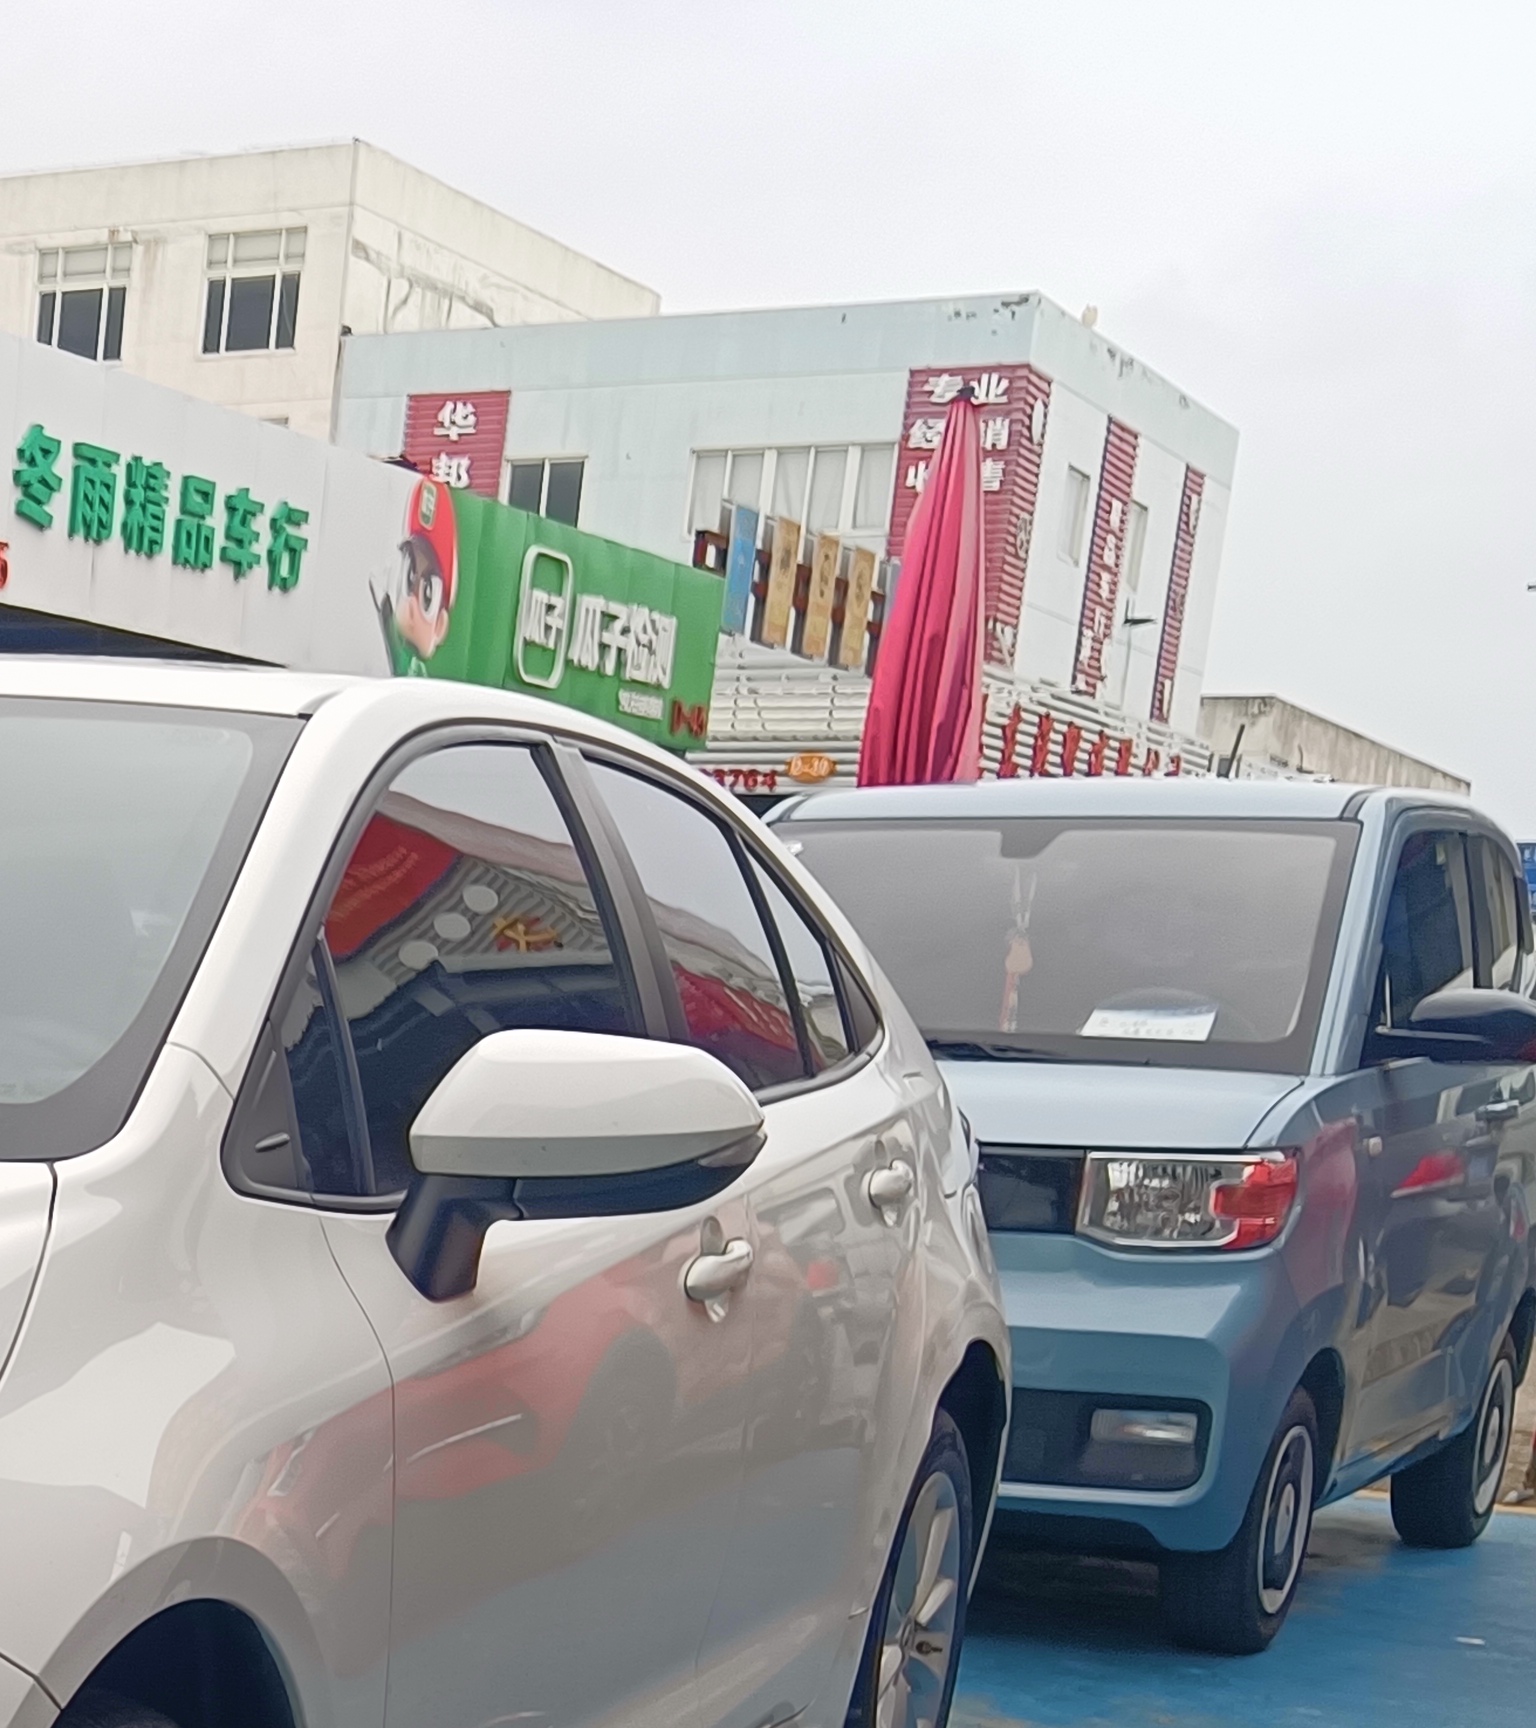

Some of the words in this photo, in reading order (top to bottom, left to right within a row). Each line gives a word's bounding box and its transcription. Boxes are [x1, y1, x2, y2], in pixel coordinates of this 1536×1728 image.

[921, 373, 1010, 405] 专业
[431, 401, 477, 488] 华邦
[13, 424, 310, 593] 冬雨精品车行
[568, 593, 678, 689] 瓜子检测
